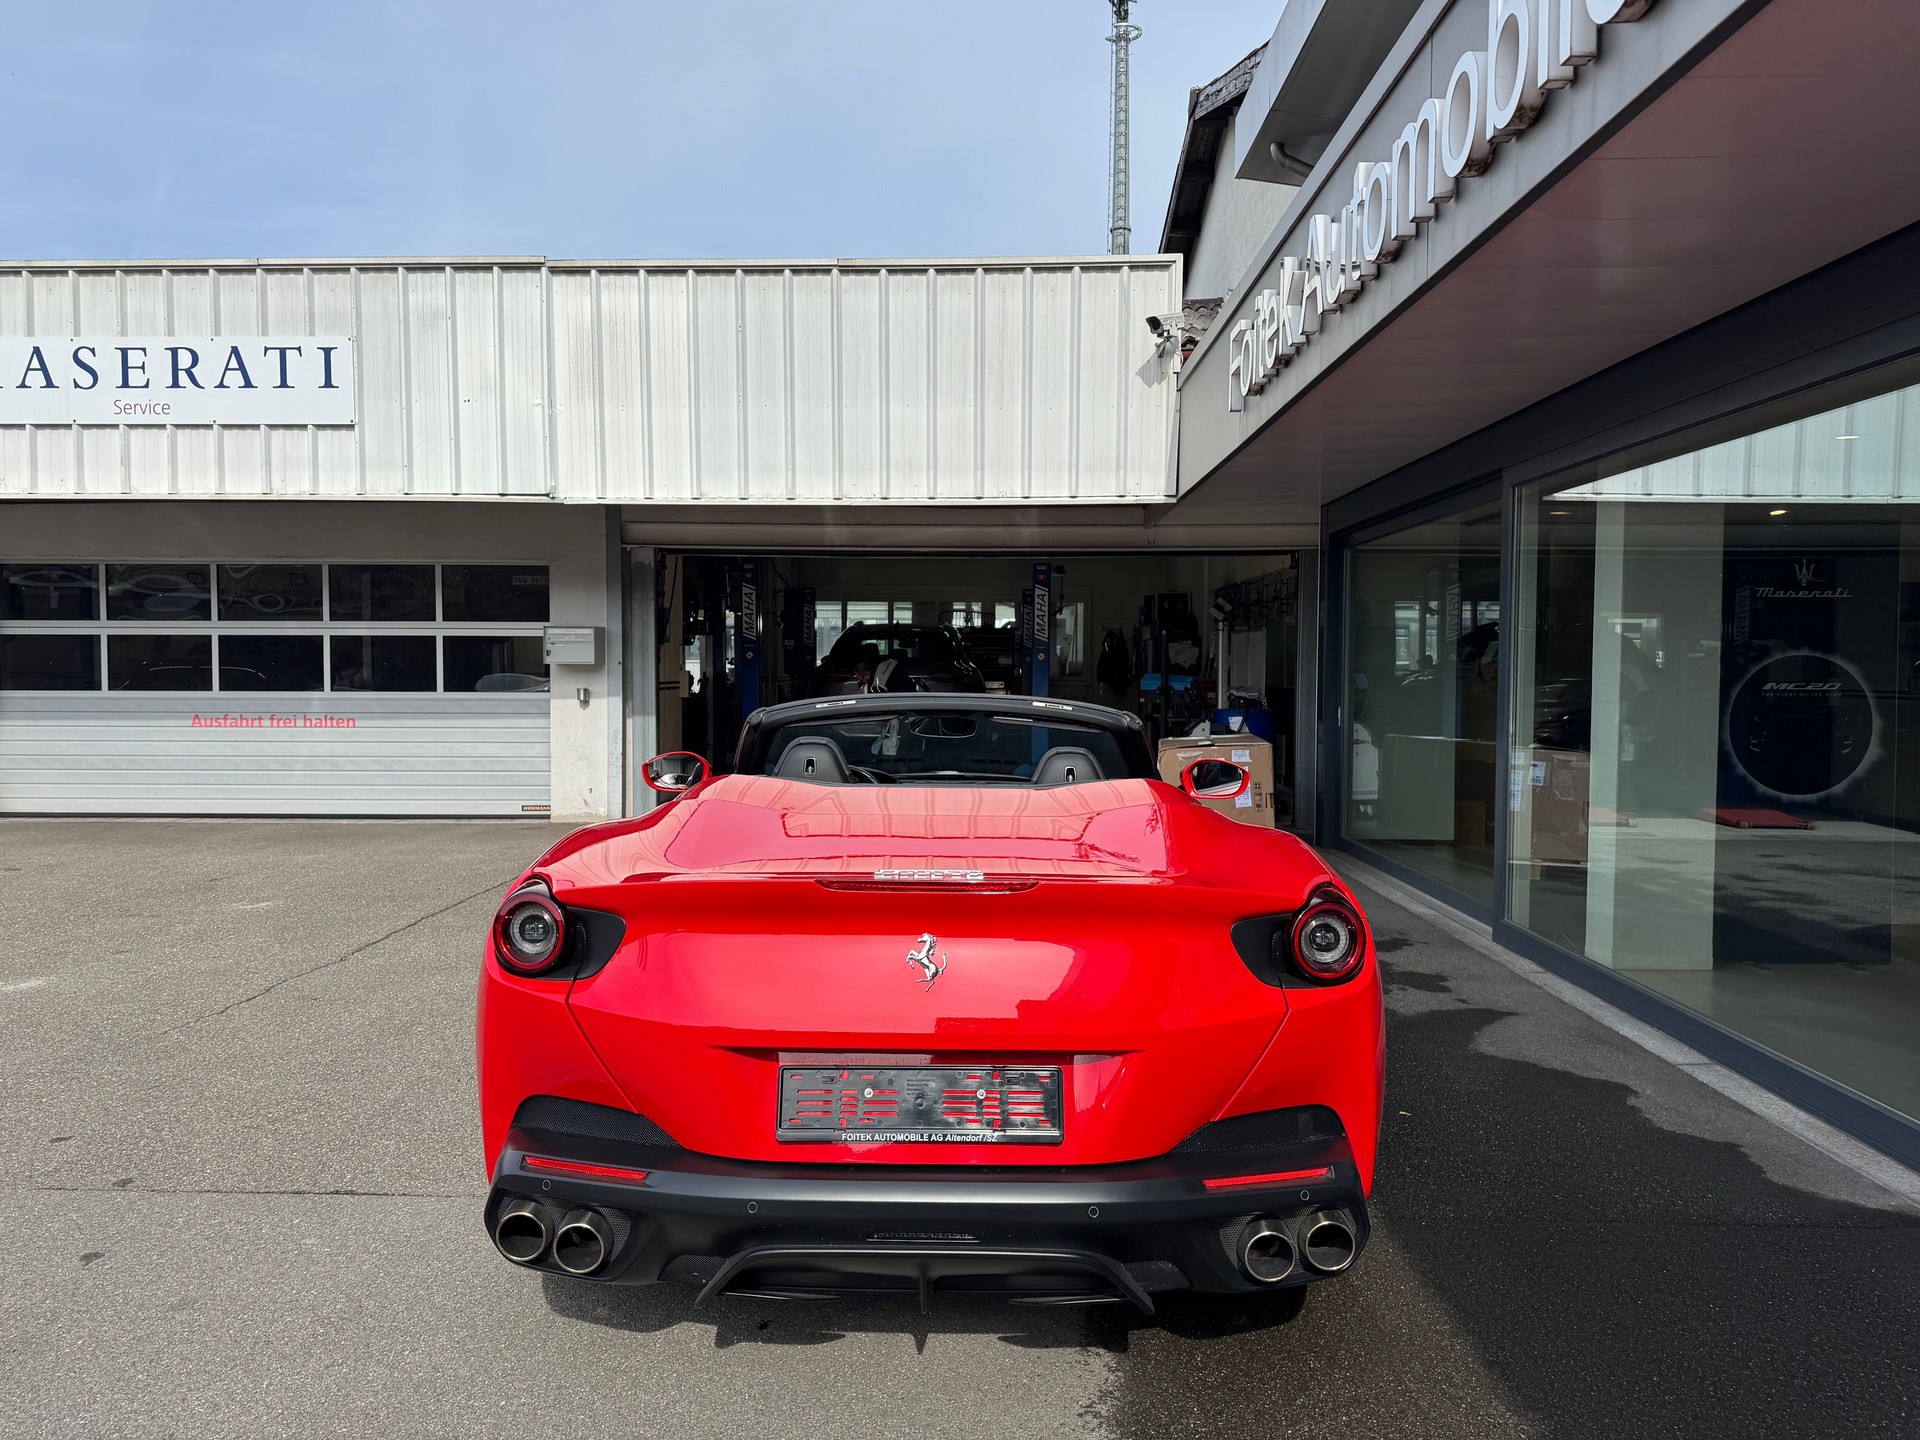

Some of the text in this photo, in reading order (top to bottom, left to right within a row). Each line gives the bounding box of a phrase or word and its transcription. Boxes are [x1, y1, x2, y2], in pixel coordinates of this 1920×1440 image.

[1228, 0, 1648, 412] Foitek Automobil
[0, 344, 341, 390] ASERATI
[113, 398, 171, 416] Service
[1753, 587, 1855, 599] Maserati
[743, 590, 755, 635] MAHA
[804, 608, 814, 642] MAHA
[1036, 591, 1047, 636] MAHA
[1761, 682, 1842, 690] MC20
[191, 713, 357, 728] Ausfahrt frei halten
[841, 1133, 872, 1142] FOITEK
[873, 1133, 929, 1142] AUTOMOBILE
[930, 1133, 943, 1142] AG
